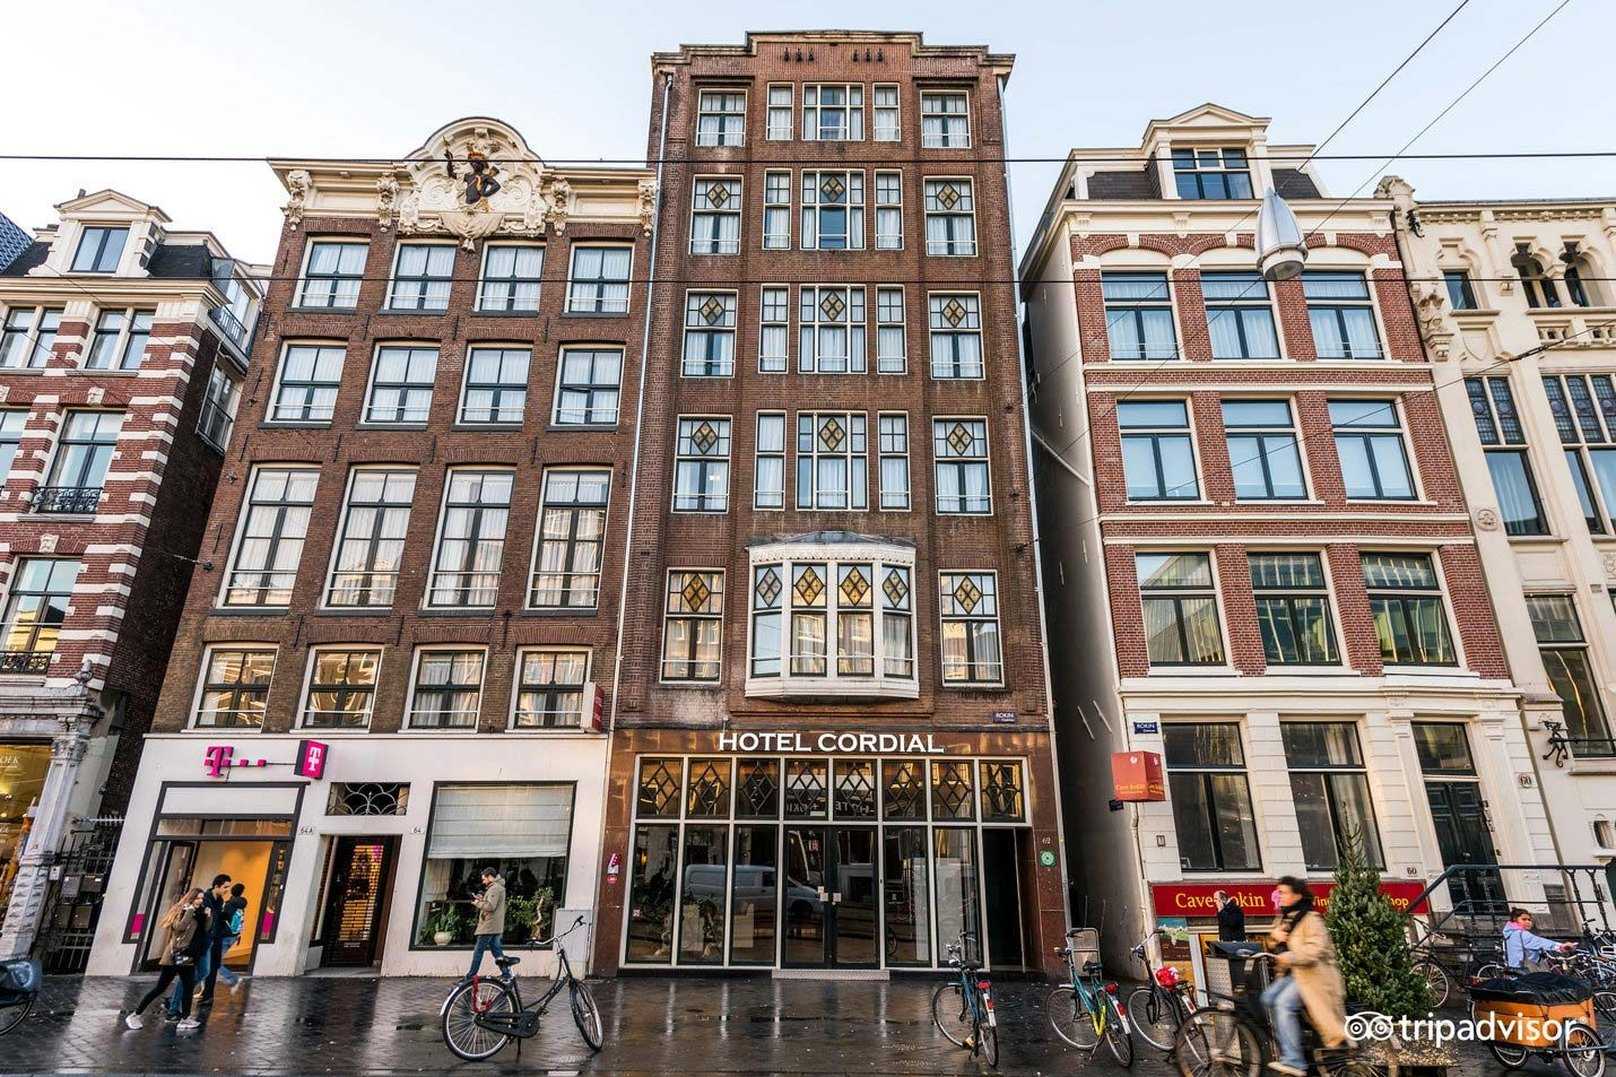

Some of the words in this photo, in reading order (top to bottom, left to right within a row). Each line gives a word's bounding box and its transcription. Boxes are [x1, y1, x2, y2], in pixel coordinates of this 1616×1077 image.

[719, 732, 811, 752] HOTEL
[818, 733, 944, 754] CORDIAL
[1407, 866, 1417, 875] 60
[1175, 893, 1214, 908] Cave
